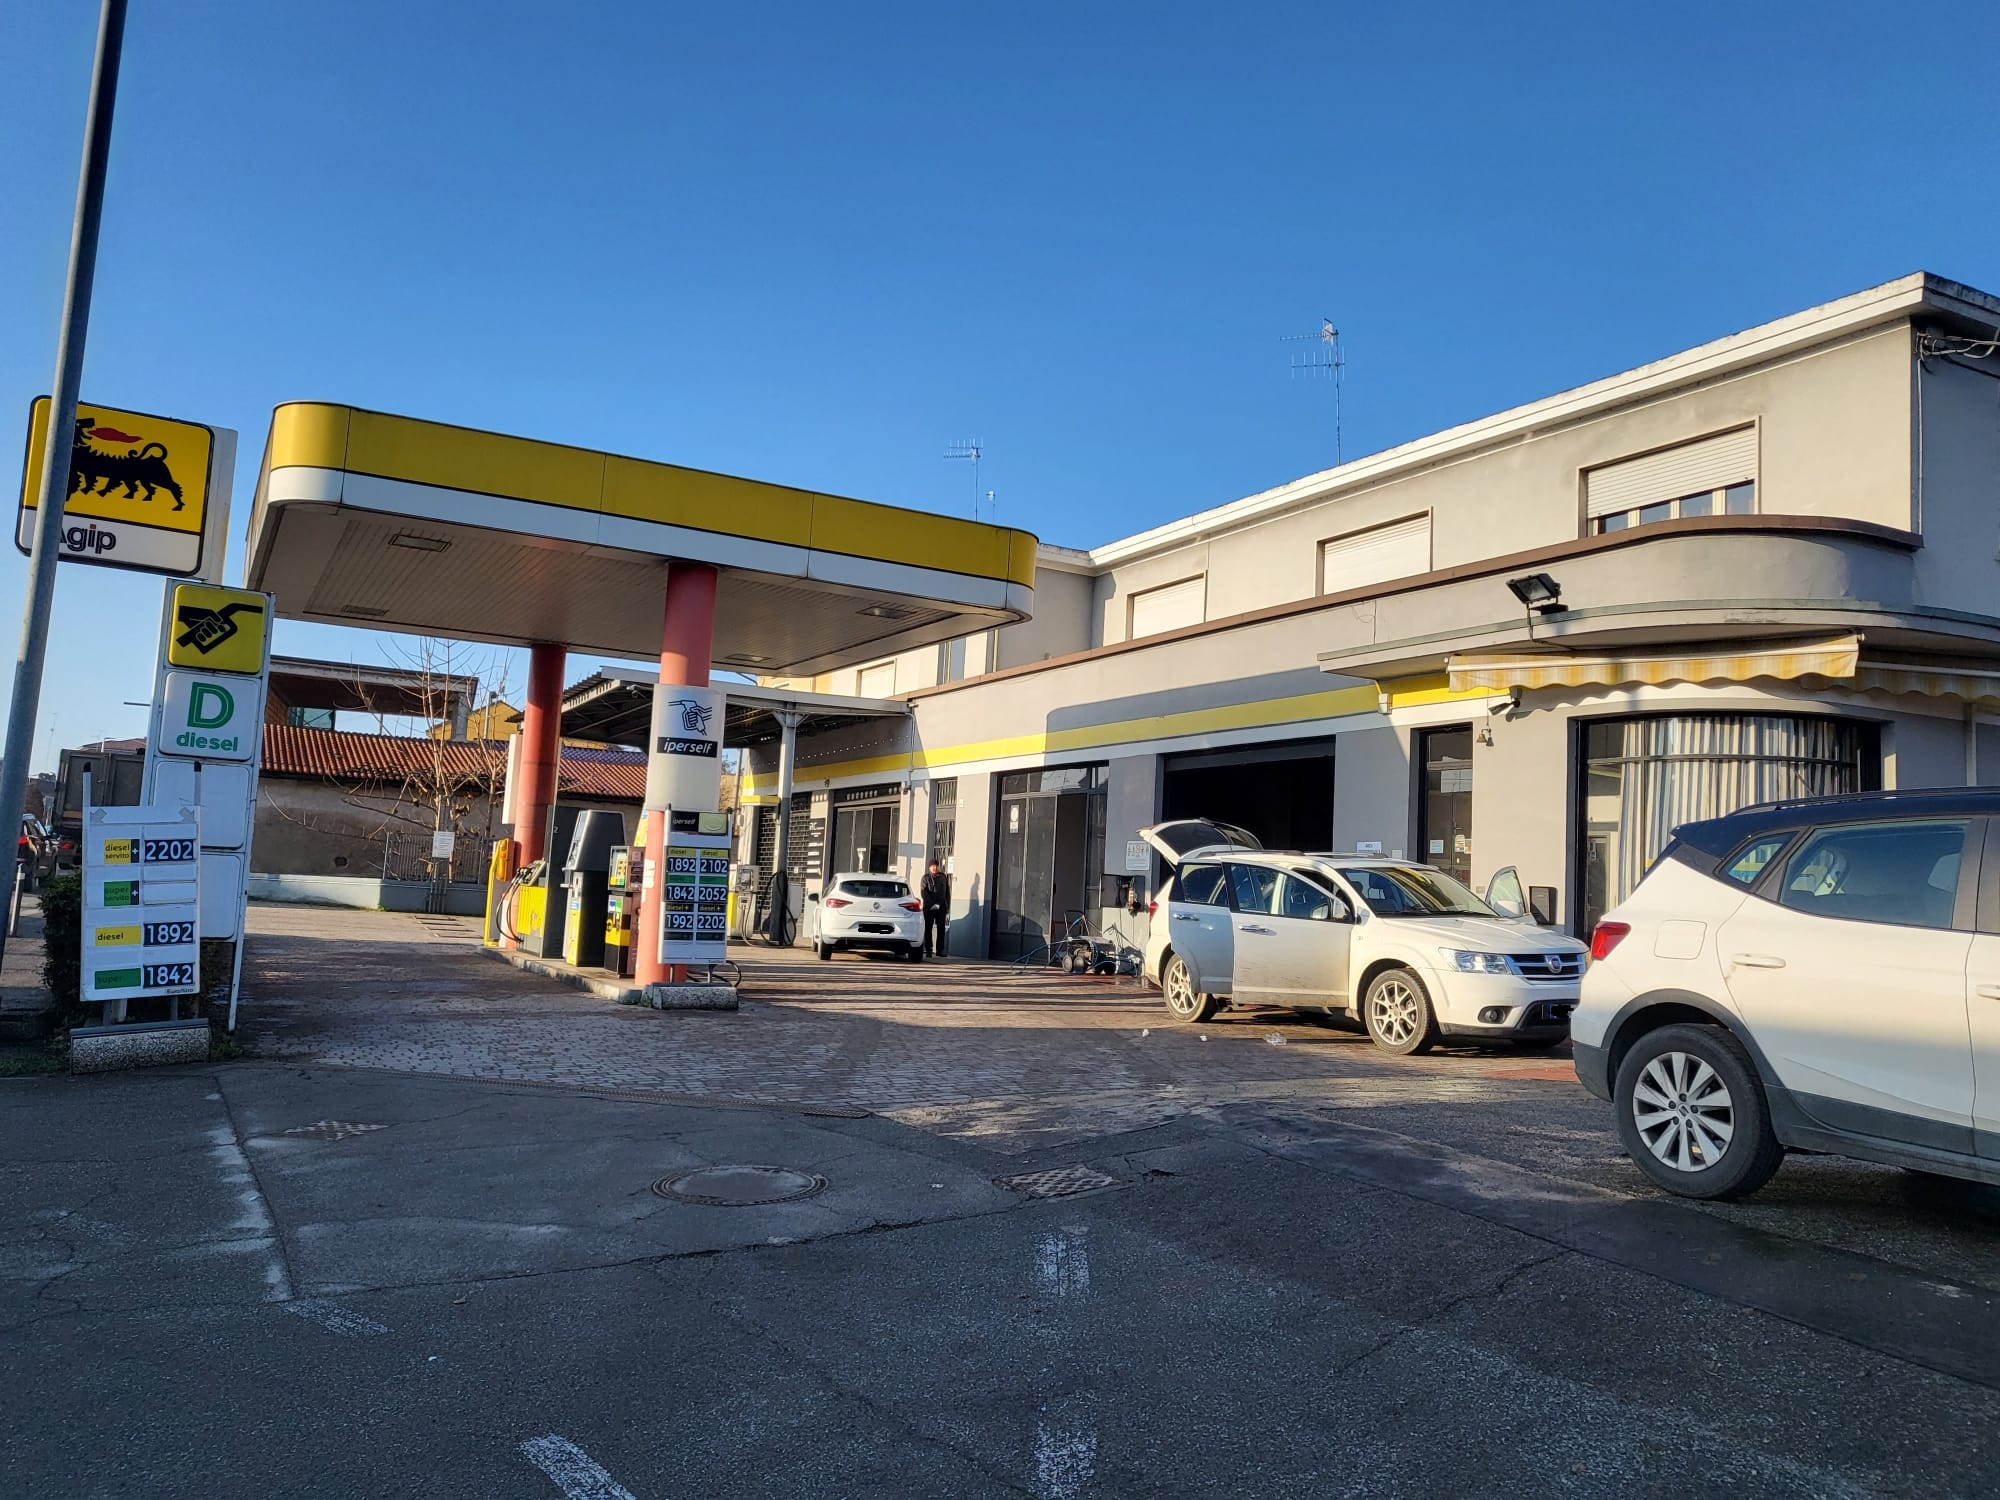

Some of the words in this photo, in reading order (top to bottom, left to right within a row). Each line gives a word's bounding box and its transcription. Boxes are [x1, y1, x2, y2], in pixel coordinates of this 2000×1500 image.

[187, 682, 235, 729] D
[176, 731, 238, 752] diesel
[105, 843, 130, 852] diesel
[145, 841, 193, 860] 2202
[105, 852, 130, 860] servito
[700, 859, 728, 873] 2102
[699, 887, 727, 901] 2052
[666, 914, 693, 928] 1992
[698, 915, 726, 929] 2202
[97, 931, 124, 941] diesel
[147, 923, 193, 944] 1892
[147, 964, 192, 986] 1842
